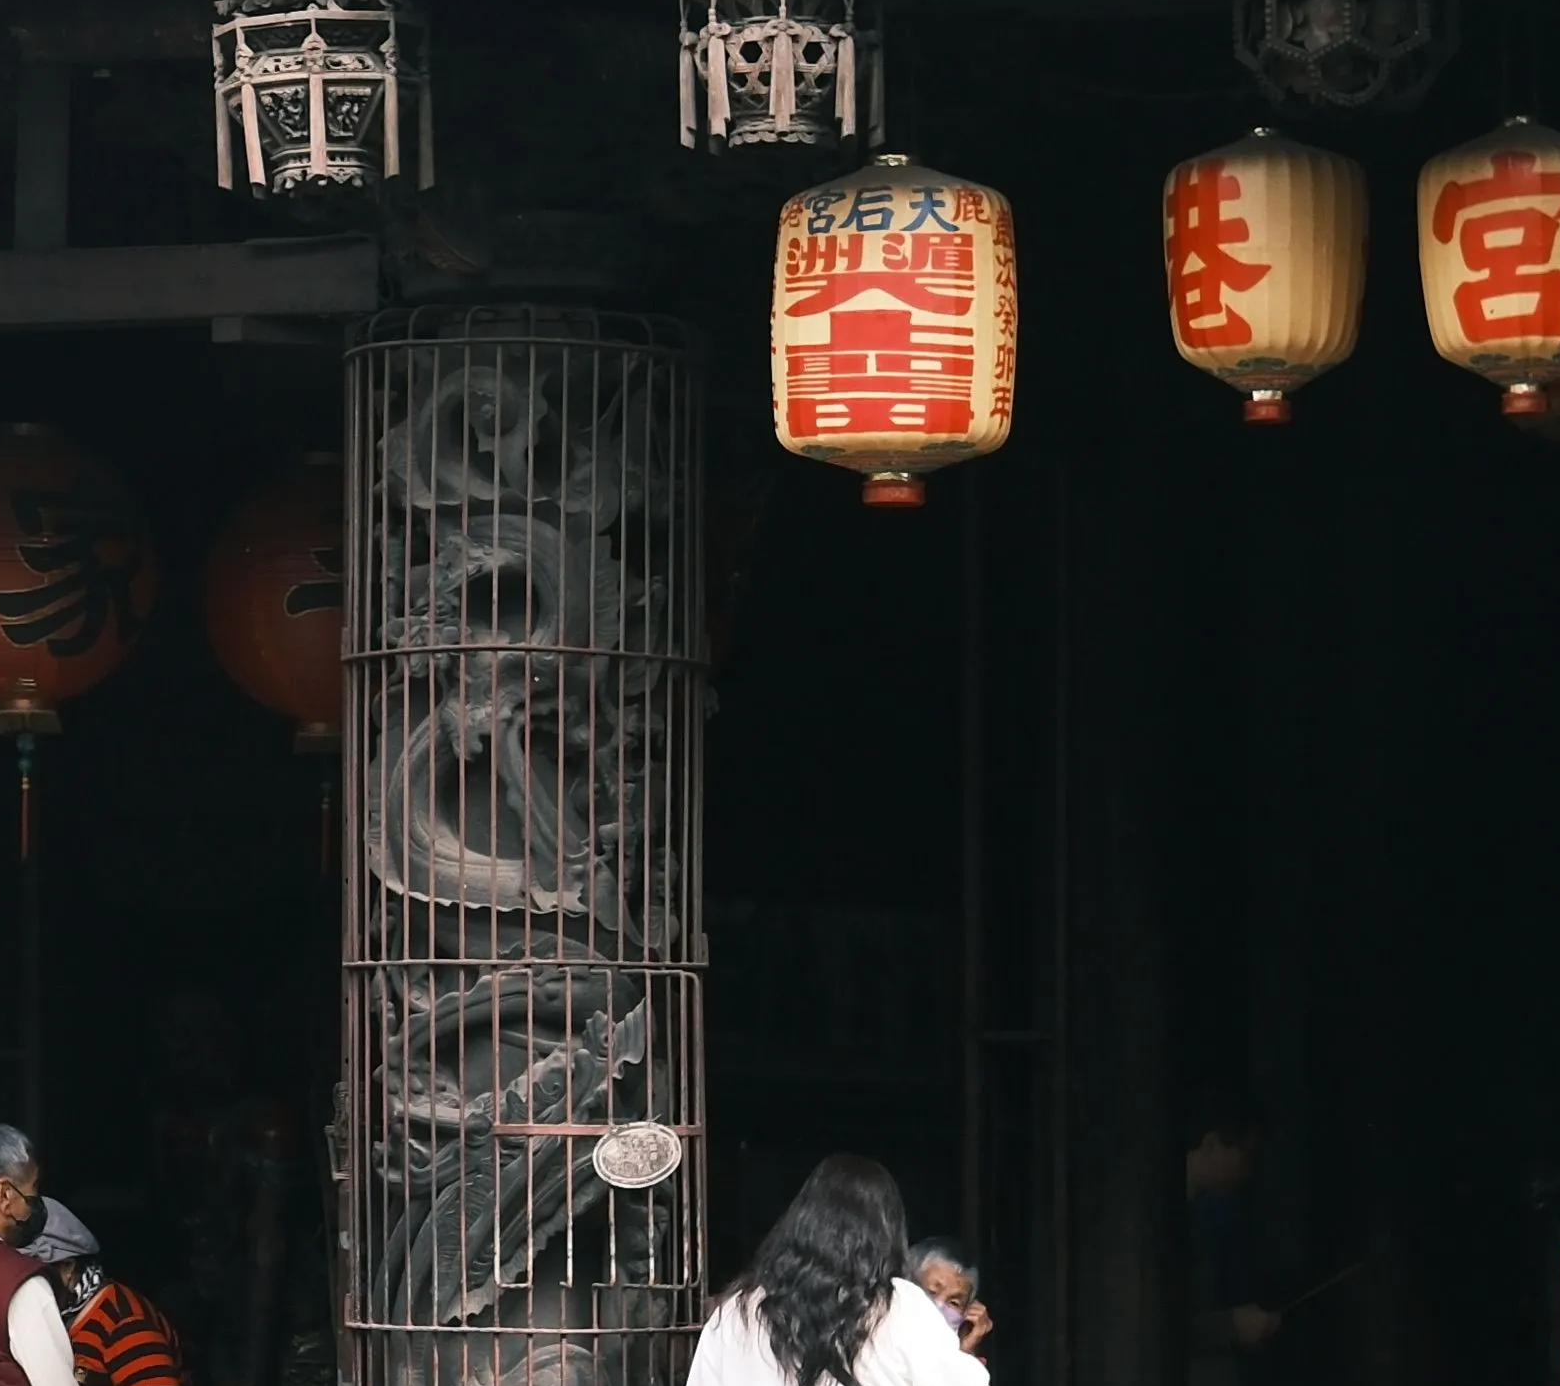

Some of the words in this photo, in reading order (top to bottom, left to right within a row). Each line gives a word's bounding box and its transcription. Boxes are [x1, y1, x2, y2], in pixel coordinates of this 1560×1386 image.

[806, 186, 959, 234] 天后宮
[1165, 157, 1272, 349] 港
